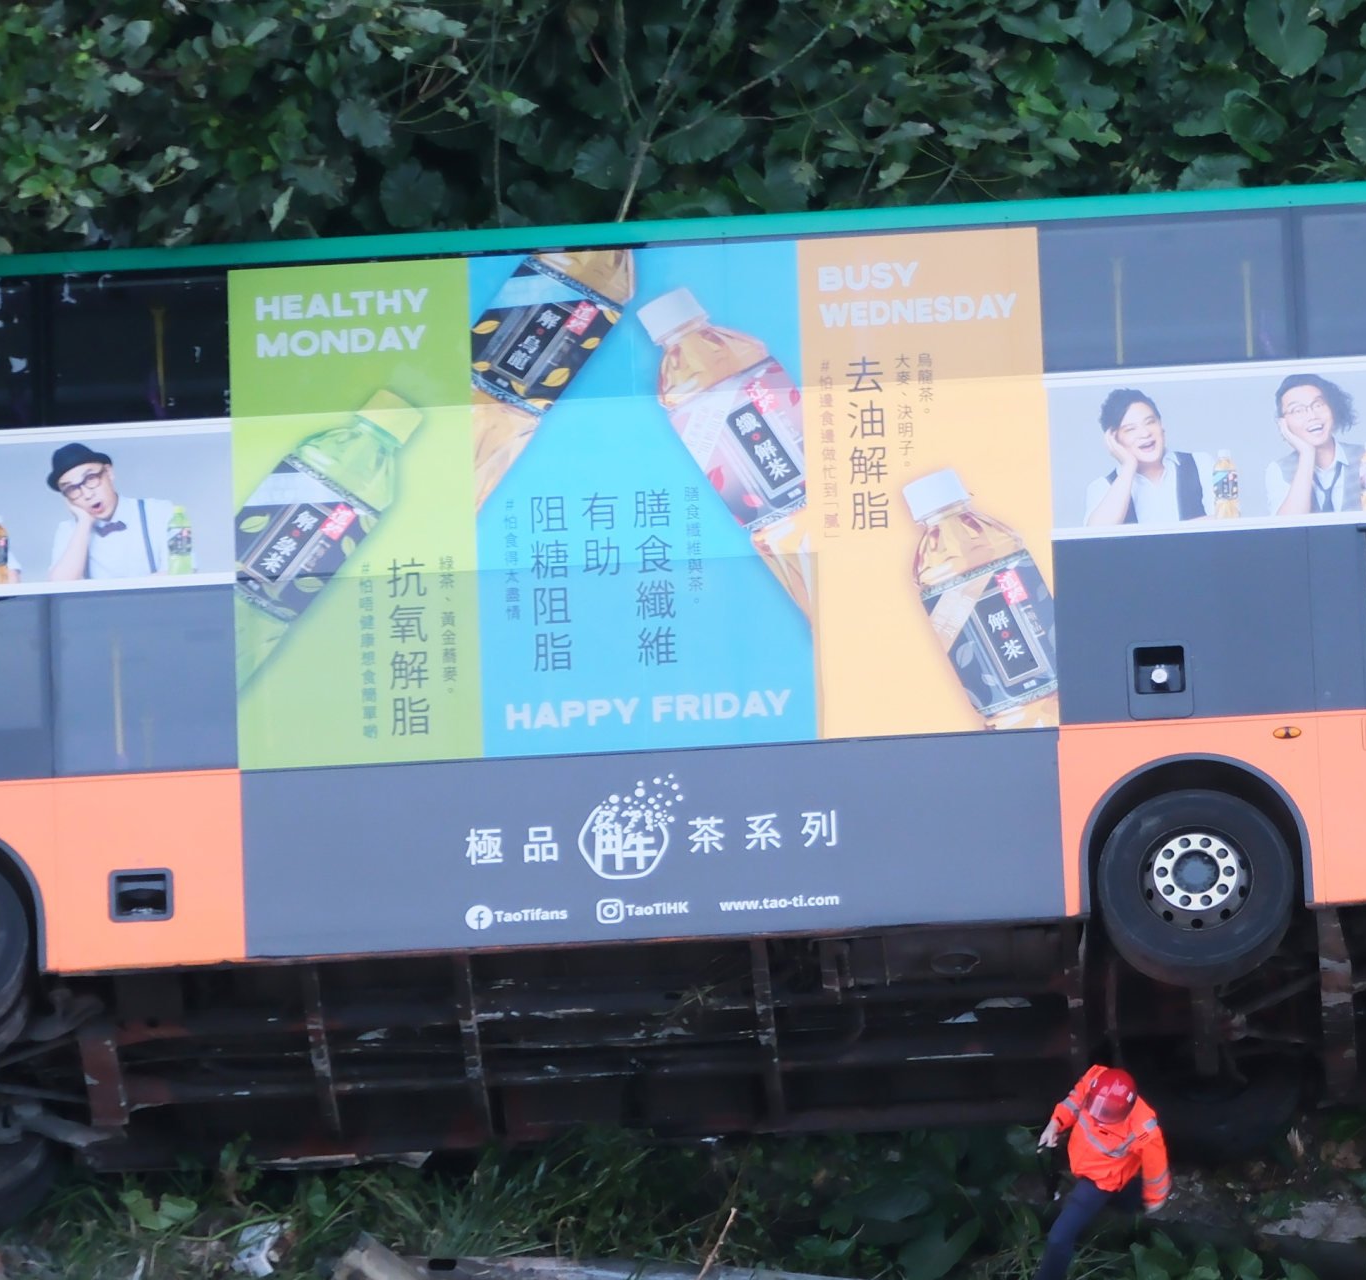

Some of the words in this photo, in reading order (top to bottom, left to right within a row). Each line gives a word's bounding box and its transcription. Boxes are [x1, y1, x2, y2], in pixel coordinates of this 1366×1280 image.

[818, 261, 919, 292] BUSY
[255, 288, 428, 321] HEALTHY
[819, 292, 1017, 328] WEDNESDAY
[256, 325, 426, 358] MONDAY
[845, 356, 889, 530] 去油解脂
[581, 492, 621, 577] 有助
[530, 495, 572, 672] 阻糖阻脂
[633, 488, 678, 666] 膳食纖維
[387, 557, 430, 736] 抗氧解脂
[505, 697, 640, 730] HAPPY
[651, 689, 791, 723] FRIDAY
[465, 826, 559, 865] 極品
[688, 810, 839, 854] 茶系列
[494, 907, 568, 923] TaoTifans
[626, 900, 689, 917] TaoTiHK
[719, 894, 840, 912] www.tao-ti.com
